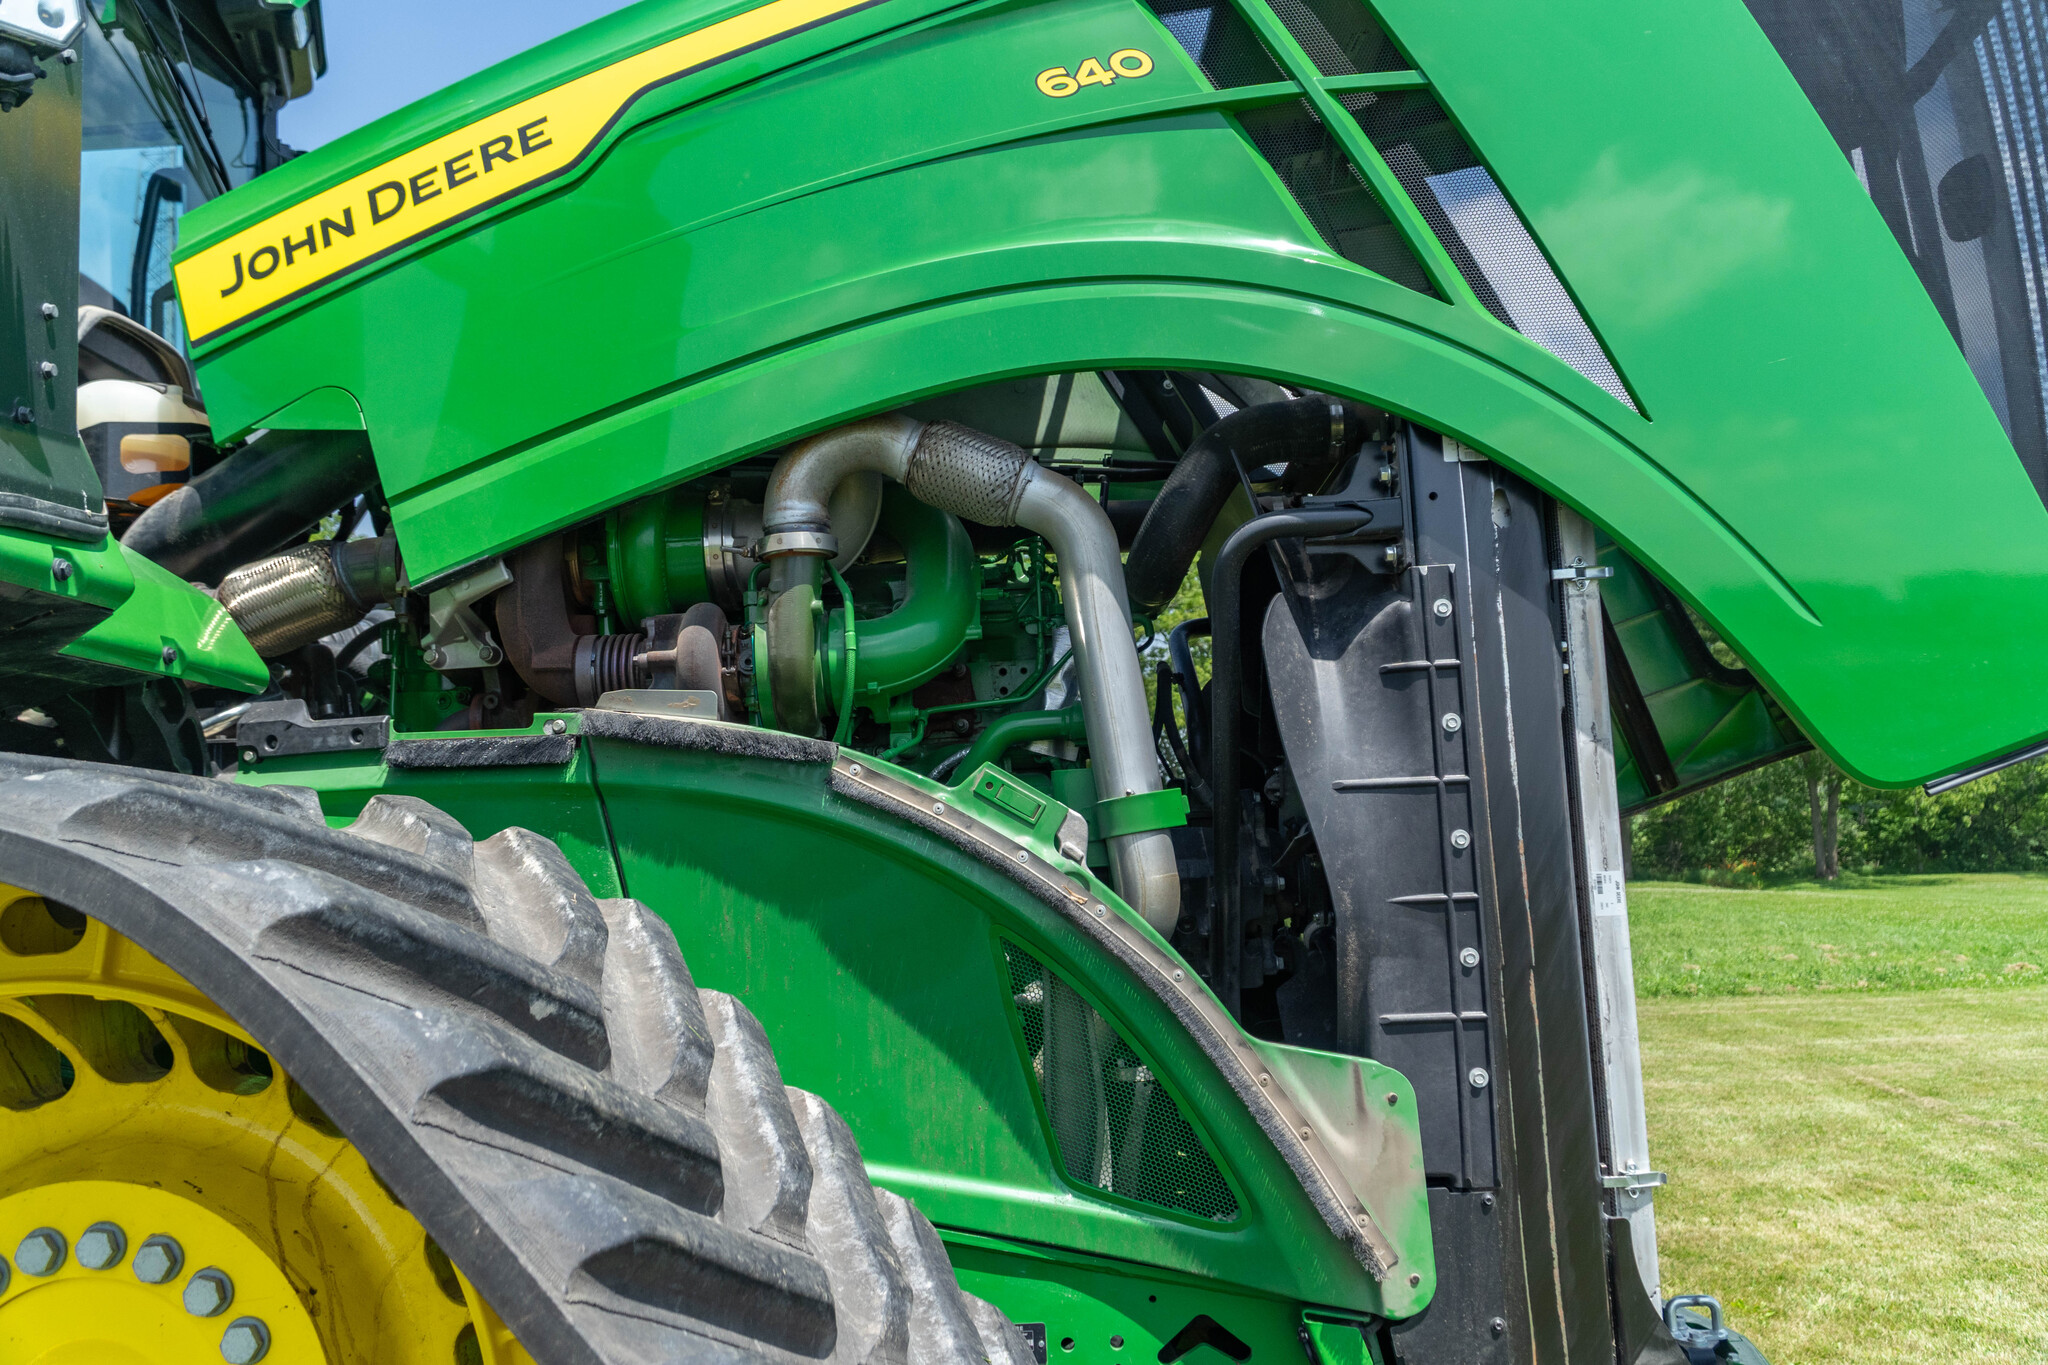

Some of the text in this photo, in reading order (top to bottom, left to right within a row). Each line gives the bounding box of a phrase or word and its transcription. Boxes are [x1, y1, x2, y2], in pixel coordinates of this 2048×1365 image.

[1035, 48, 1154, 98] 640
[220, 116, 553, 298] JOHN DEERE
